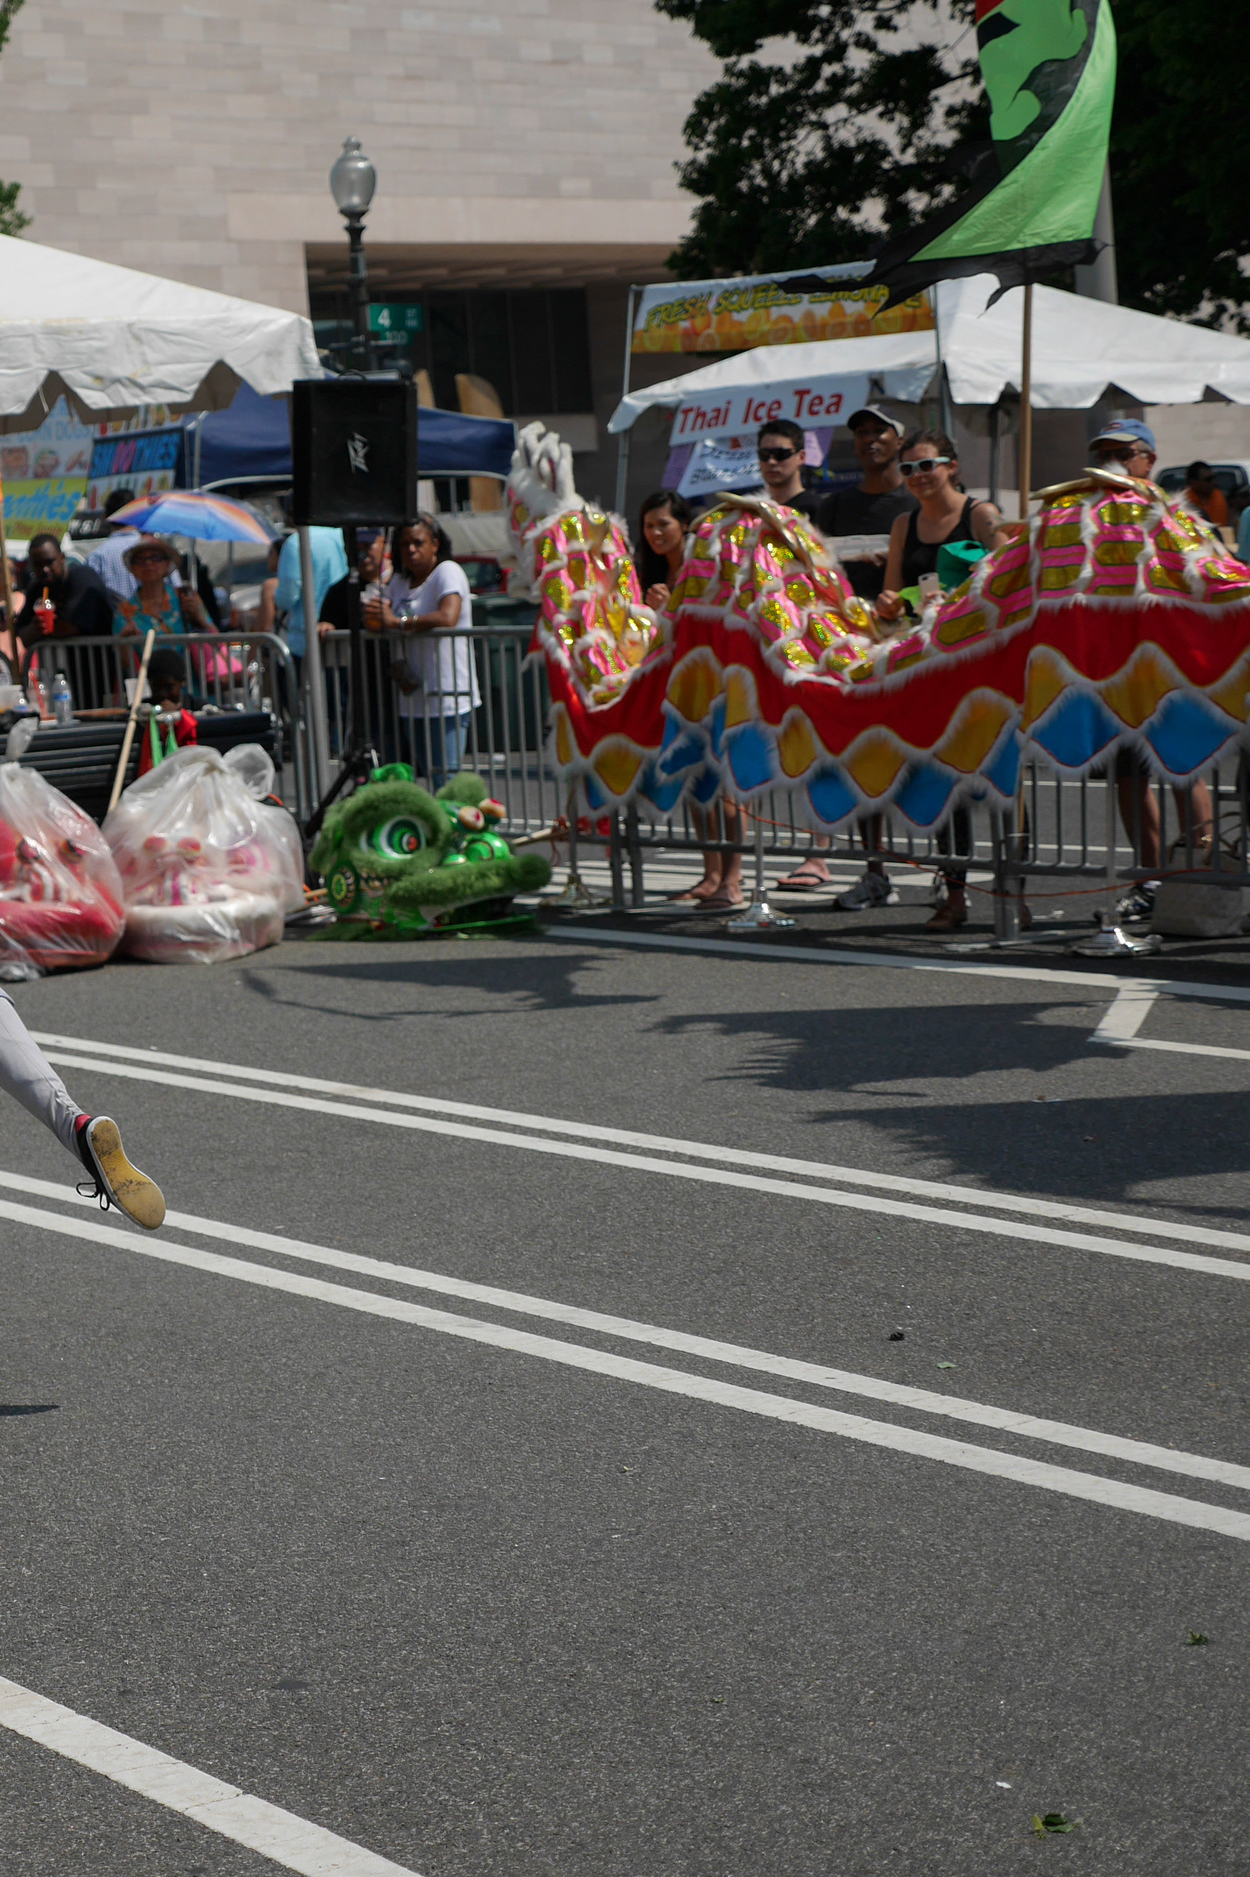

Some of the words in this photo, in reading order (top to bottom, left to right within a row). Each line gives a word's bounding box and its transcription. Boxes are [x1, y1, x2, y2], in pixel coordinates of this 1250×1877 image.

[377, 308, 391, 328] 4
[643, 289, 712, 332] FRESH
[678, 401, 732, 434] Thai
[742, 398, 783, 425] Ice
[793, 389, 844, 418] Tea
